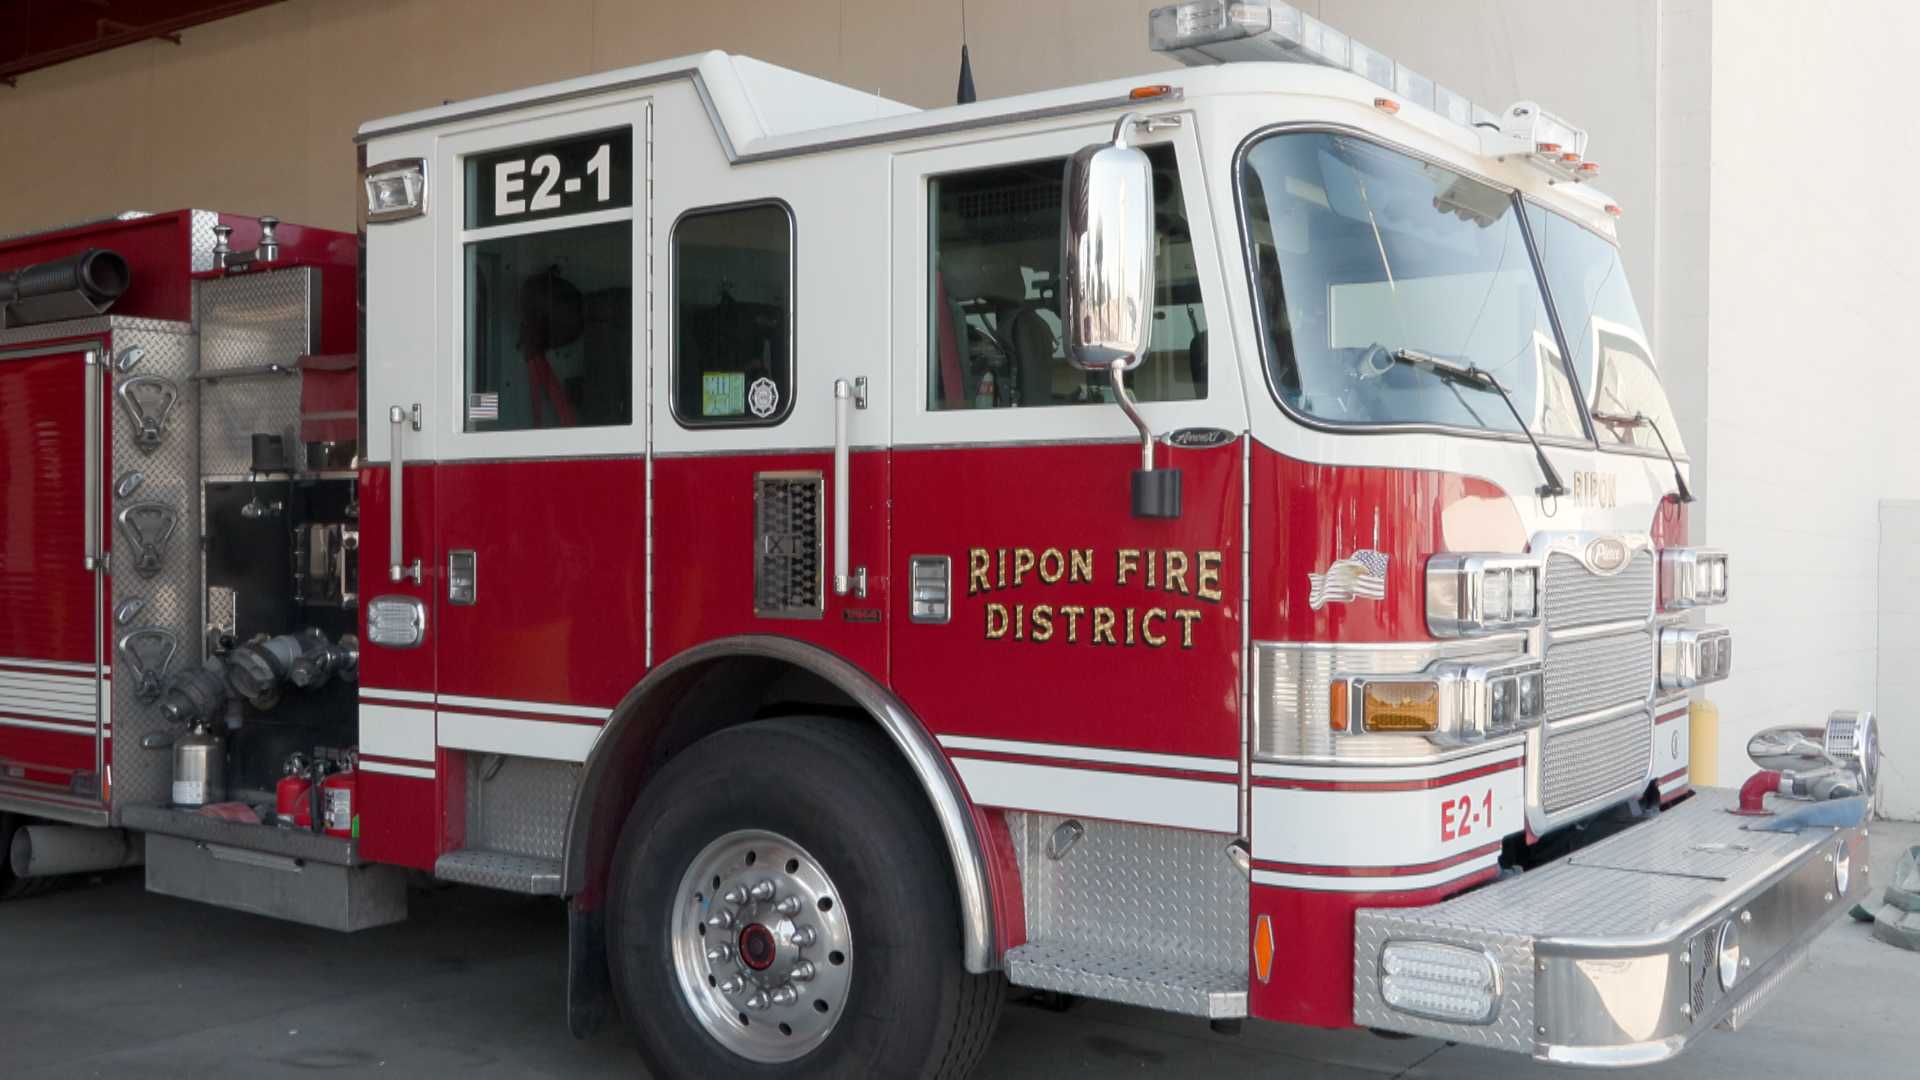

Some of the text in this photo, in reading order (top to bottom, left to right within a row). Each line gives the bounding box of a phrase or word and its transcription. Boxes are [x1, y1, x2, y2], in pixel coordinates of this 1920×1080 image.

[495, 143, 611, 217] E2-1
[1573, 471, 1617, 509] RIPON
[968, 547, 1222, 602] RIPON FIRE
[985, 602, 1201, 648] DISTRICT
[1441, 788, 1492, 842] E2-1
